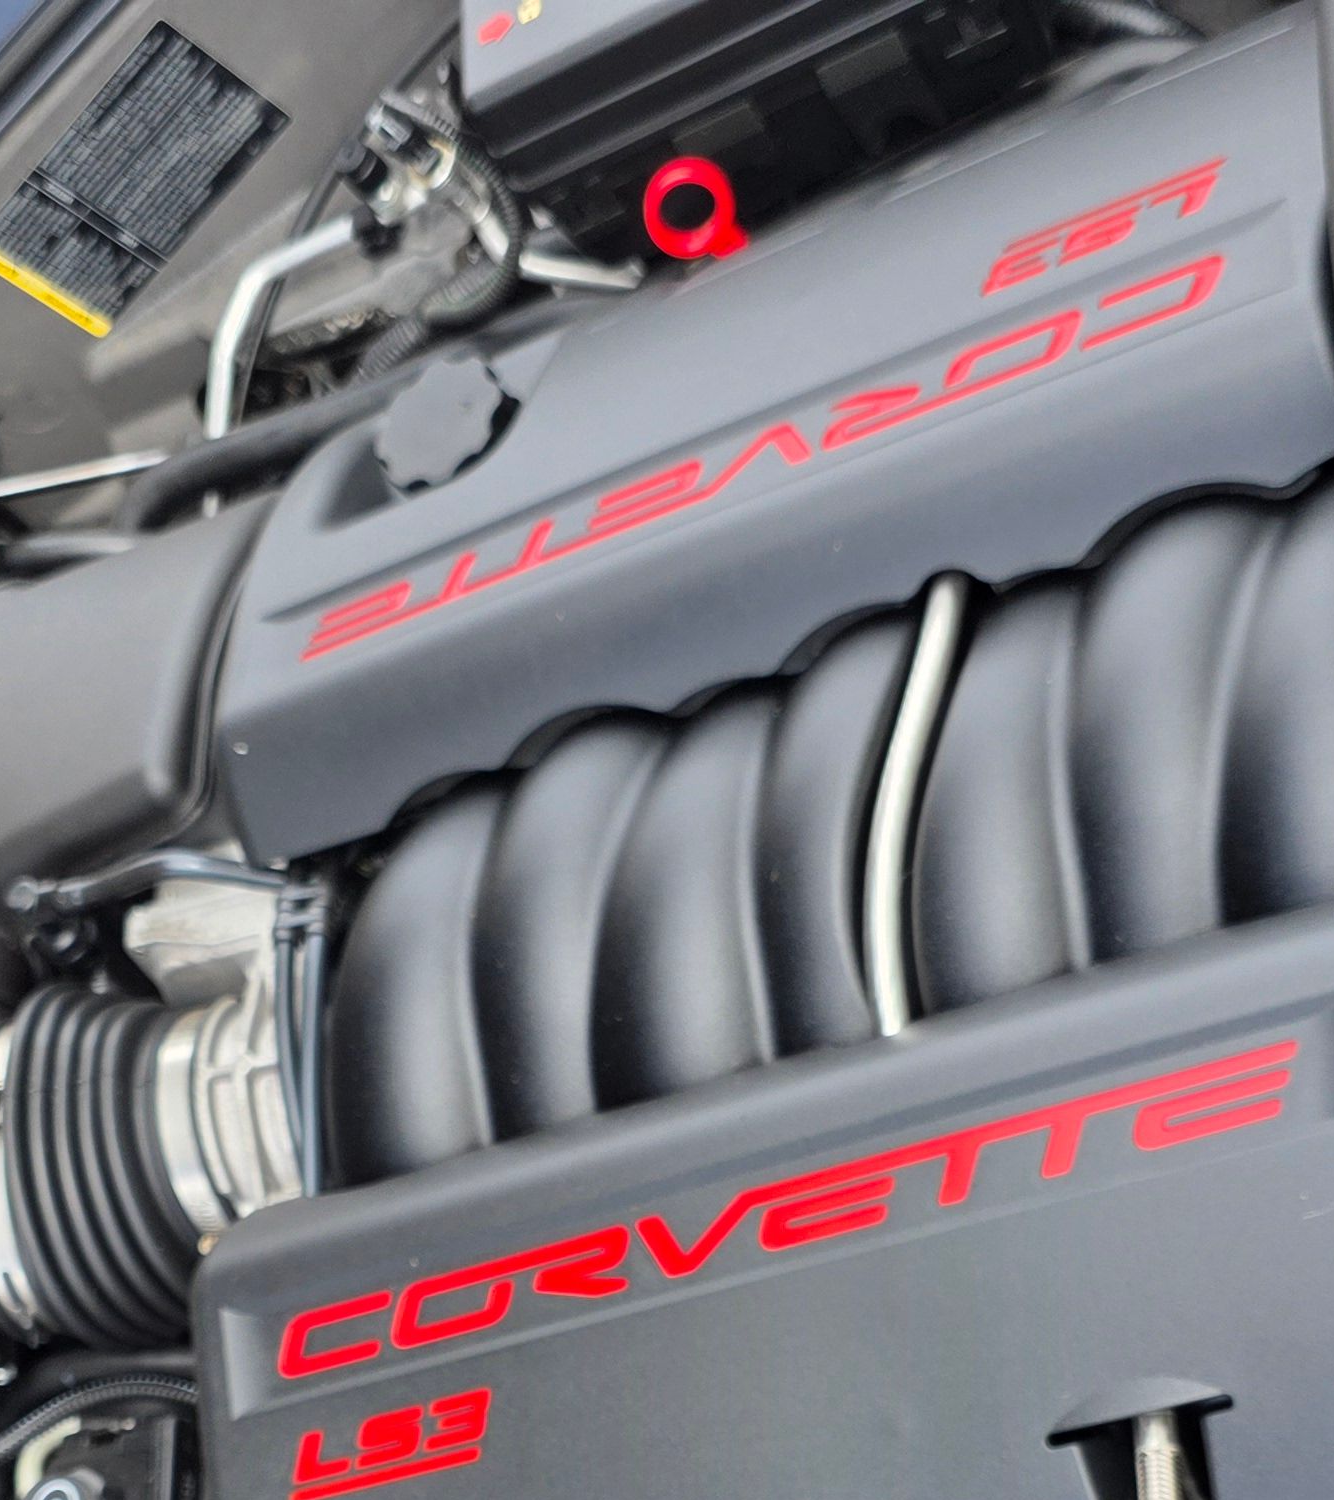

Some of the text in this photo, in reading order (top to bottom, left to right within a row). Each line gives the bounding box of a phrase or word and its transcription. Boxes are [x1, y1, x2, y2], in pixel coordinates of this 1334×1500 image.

[982, 164, 1221, 296] LS3
[301, 255, 1225, 661] CORVETTE
[276, 1039, 1298, 1380] CORVETTE
[291, 1386, 492, 1487] LS3
